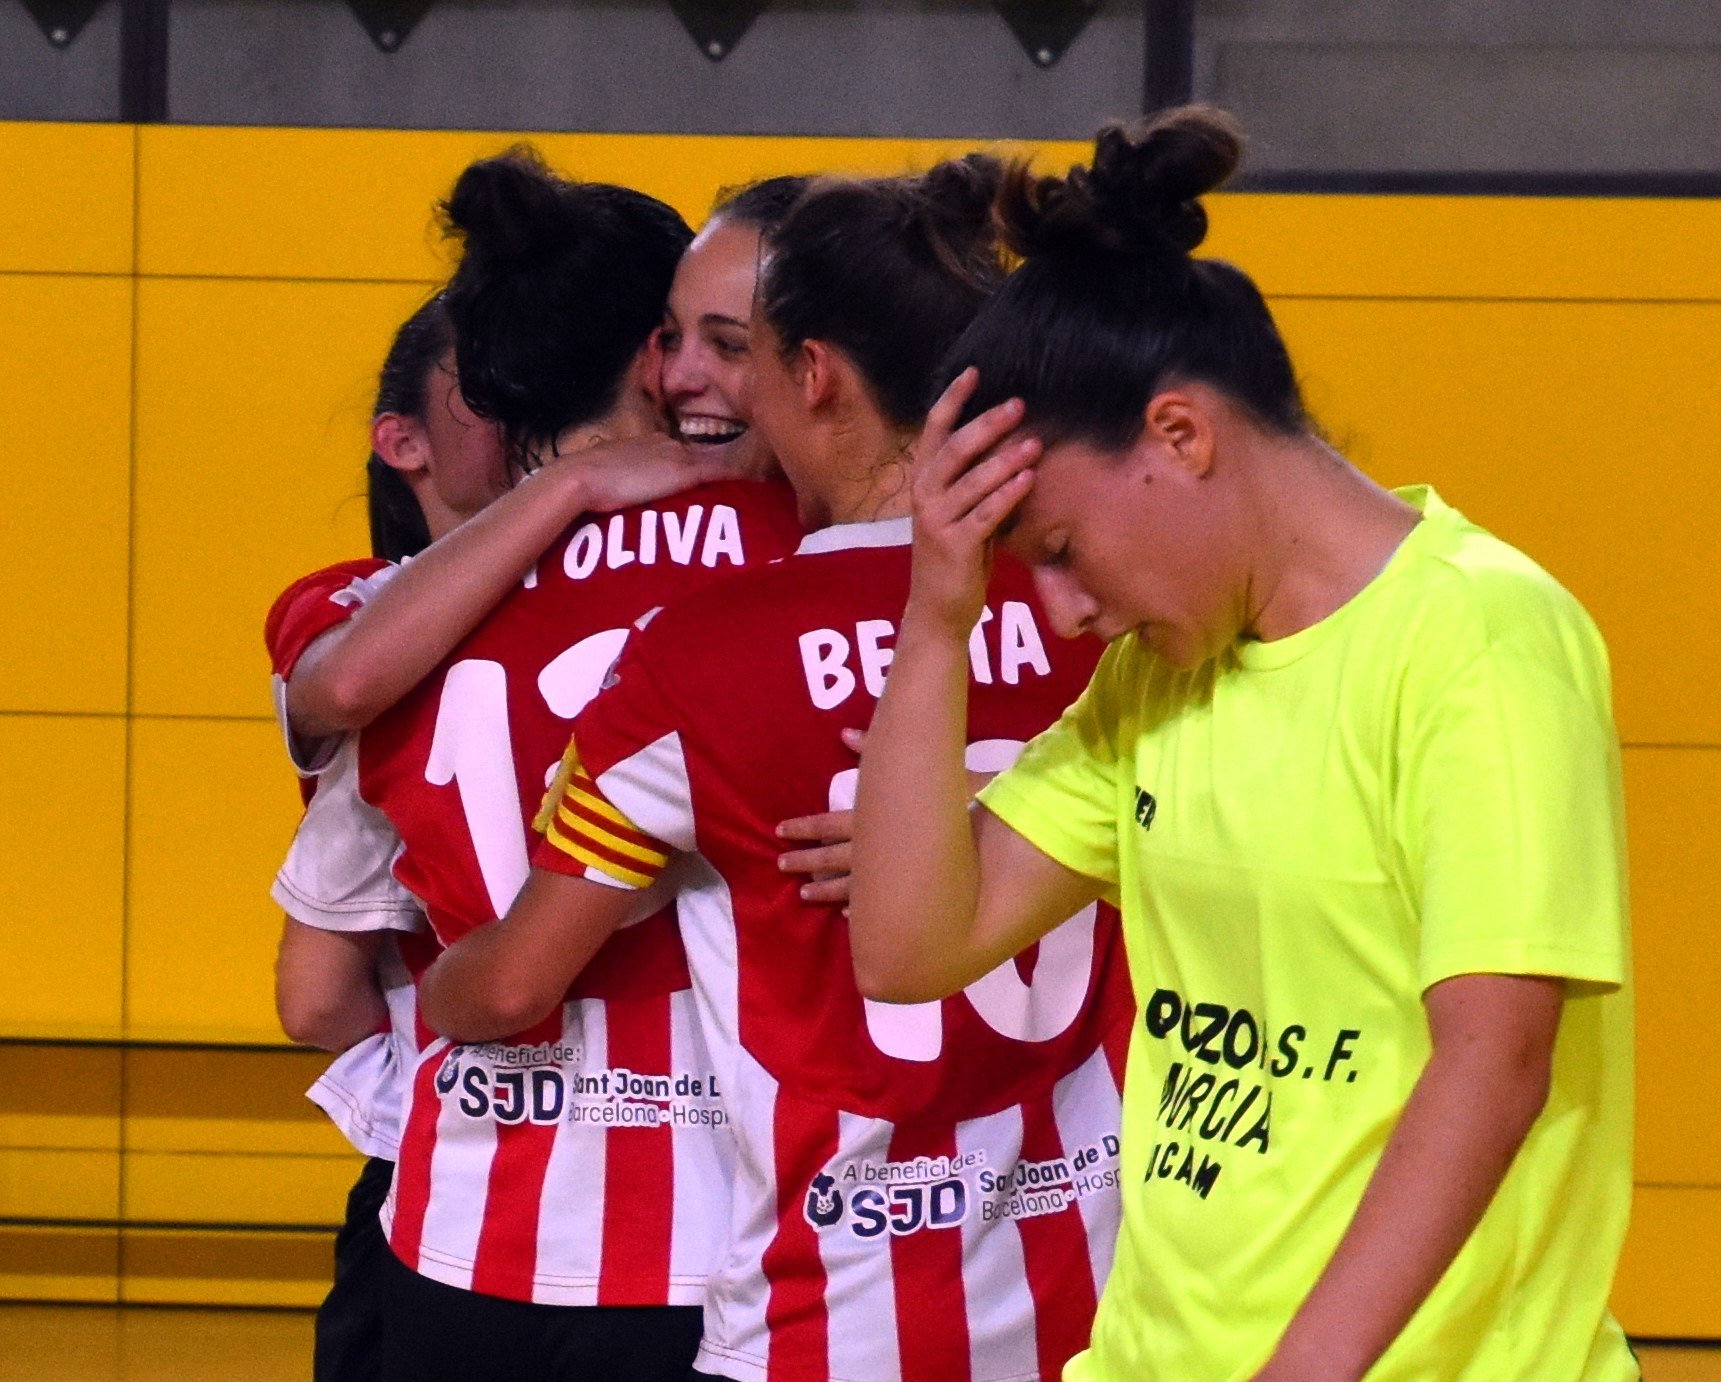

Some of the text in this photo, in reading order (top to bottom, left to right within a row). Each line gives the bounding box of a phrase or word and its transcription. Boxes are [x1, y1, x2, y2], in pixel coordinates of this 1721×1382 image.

[563, 504, 746, 580] OLIVA
[798, 600, 1052, 710] BETA
[459, 1065, 565, 1122] SJD
[614, 1072, 670, 1097] Joan
[674, 1074, 703, 1097] de
[843, 1164, 858, 1181] A
[864, 1159, 947, 1181] benefici
[1016, 1162, 1070, 1187] Joan
[1073, 1147, 1100, 1172] de
[850, 1179, 967, 1238] SJD
